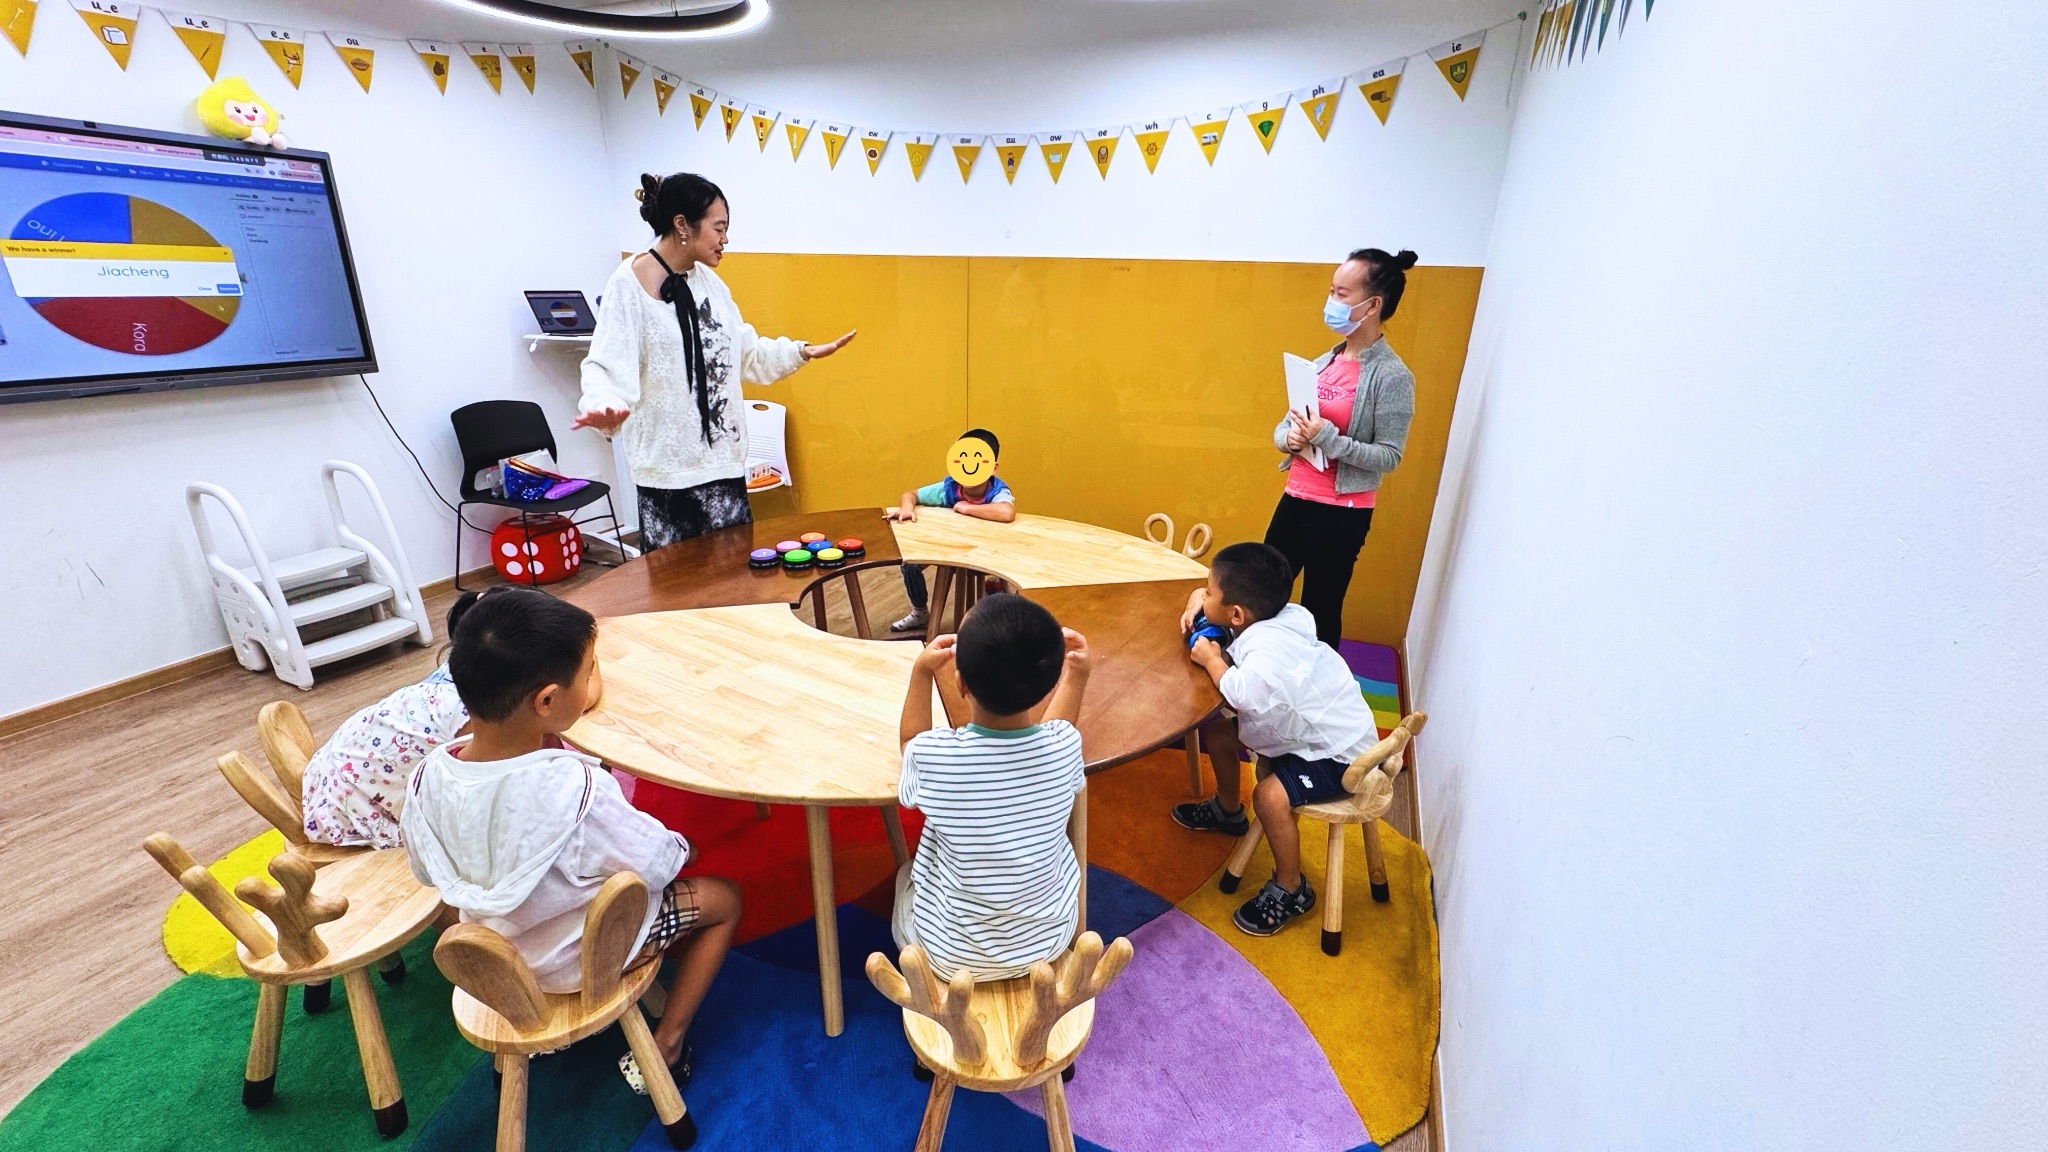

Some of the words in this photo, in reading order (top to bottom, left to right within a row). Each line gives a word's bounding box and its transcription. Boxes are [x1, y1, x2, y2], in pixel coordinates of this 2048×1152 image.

[92, 0, 118, 14] u_e
[184, 16, 209, 29] u_e
[270, 29, 290, 40] e_e
[346, 38, 360, 46] ou
[1451, 41, 1462, 53] ie
[661, 73, 669, 82] ch
[1372, 68, 1386, 79] ea
[697, 88, 705, 97] ch
[1311, 84, 1326, 98] ph
[1262, 100, 1269, 111] g
[1206, 112, 1212, 121] c
[828, 125, 839, 133] ew
[1144, 121, 1159, 131] wh
[868, 130, 879, 138] ew
[1049, 134, 1062, 142] ow
[1097, 129, 1108, 138] oe
[915, 135, 922, 145] y
[97, 266, 170, 279] Jiacheng
[132, 322, 148, 352] Kora
